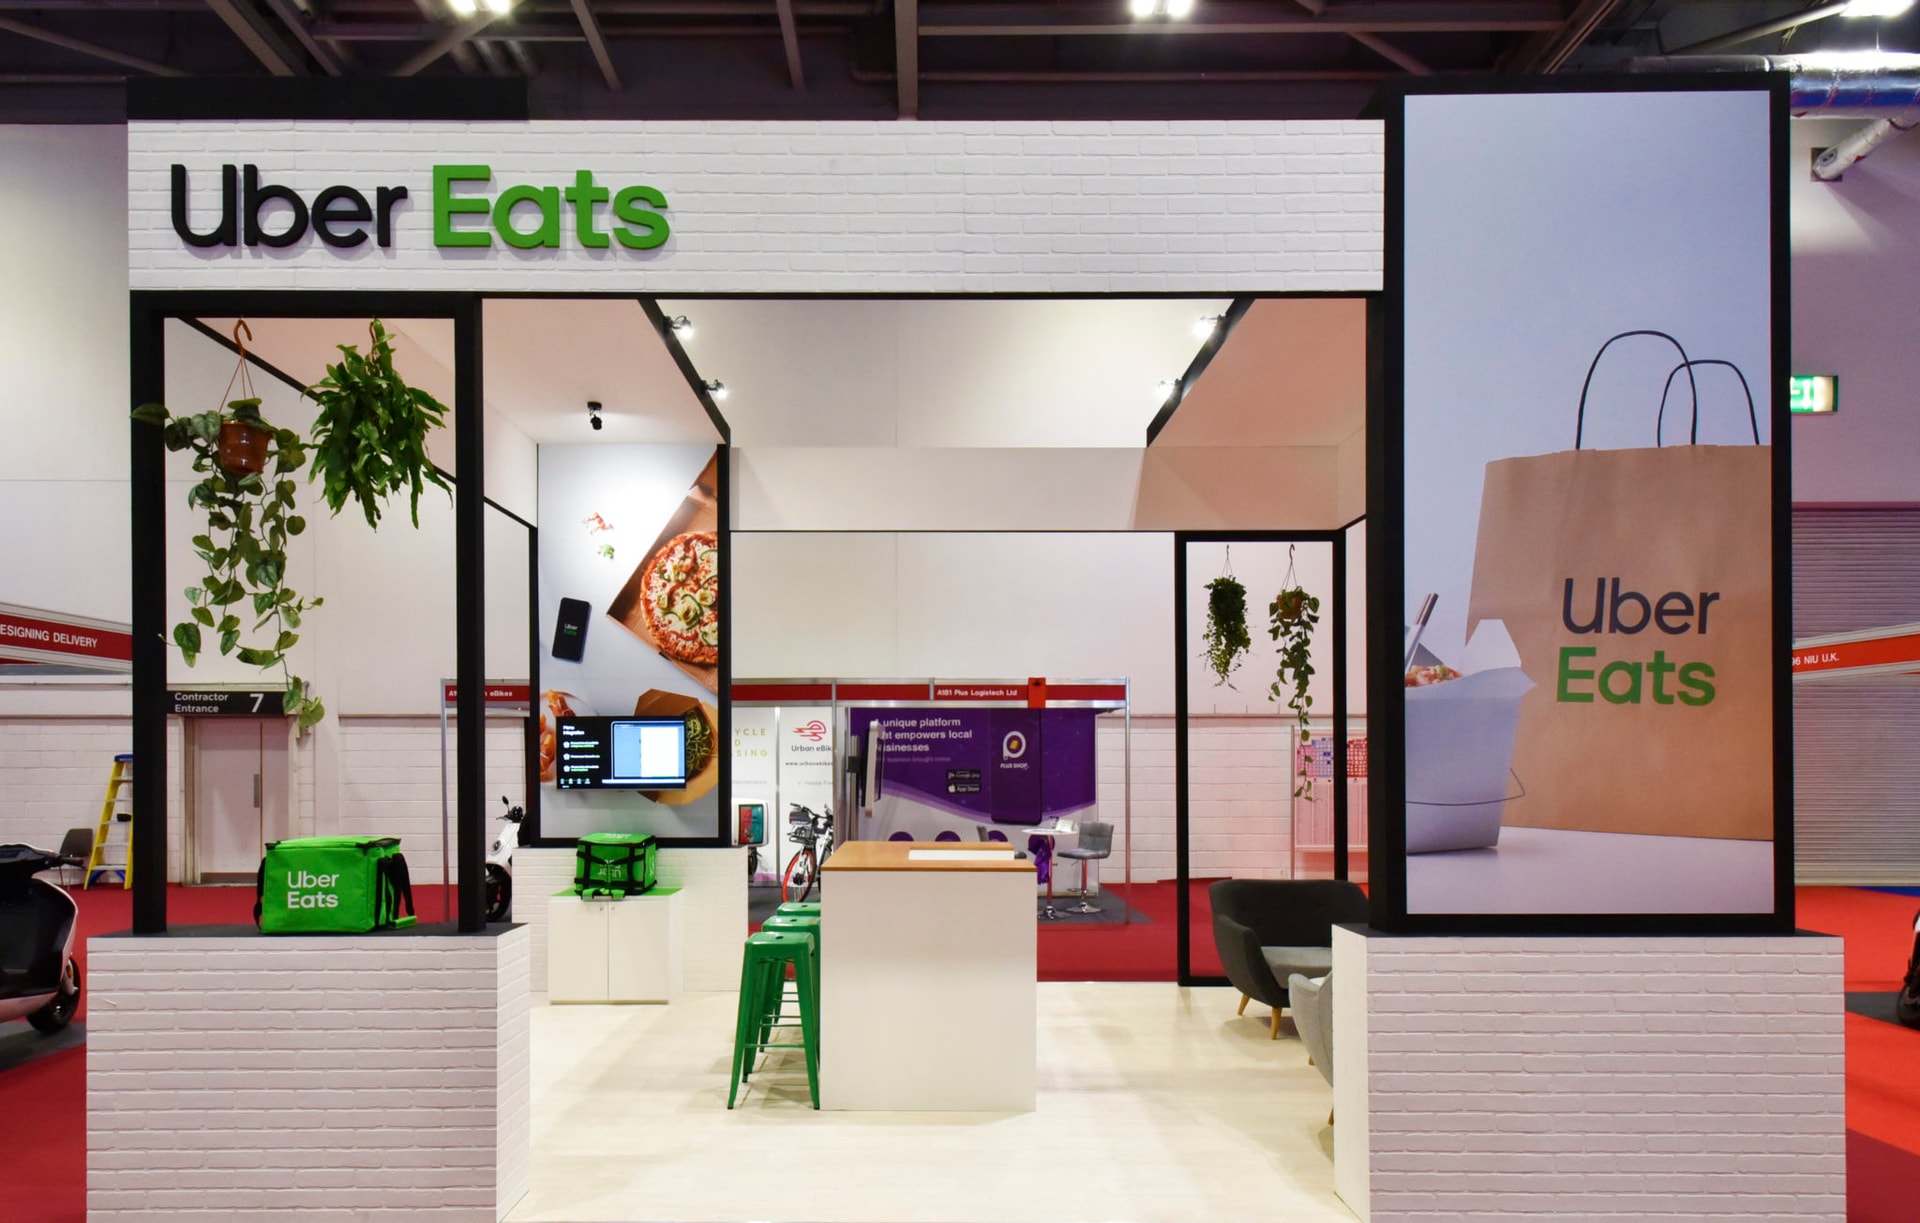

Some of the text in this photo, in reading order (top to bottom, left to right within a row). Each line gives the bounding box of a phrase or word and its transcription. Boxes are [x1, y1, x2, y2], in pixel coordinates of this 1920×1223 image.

[171, 164, 670, 249] Uber Eats
[1562, 577, 1720, 635] Uber
[0, 624, 98, 648] ESIGNING DELIVERY
[1804, 655, 1819, 665] NIU
[1821, 652, 1840, 663] U.K.
[1556, 647, 1716, 706] Eats
[970, 689, 1004, 697] Logistech
[174, 692, 264, 713] Contractor 7
[174, 704, 219, 713] Entrance
[882, 717, 961, 729] unique platform
[734, 728, 767, 736] YCLE
[894, 731, 946, 741] empowers
[948, 729, 973, 739] local
[736, 749, 768, 757] SING
[791, 744, 831, 752] Urban eBik
[883, 743, 930, 752] sinesses
[287, 871, 340, 888] Uber
[287, 891, 339, 908] Eats
